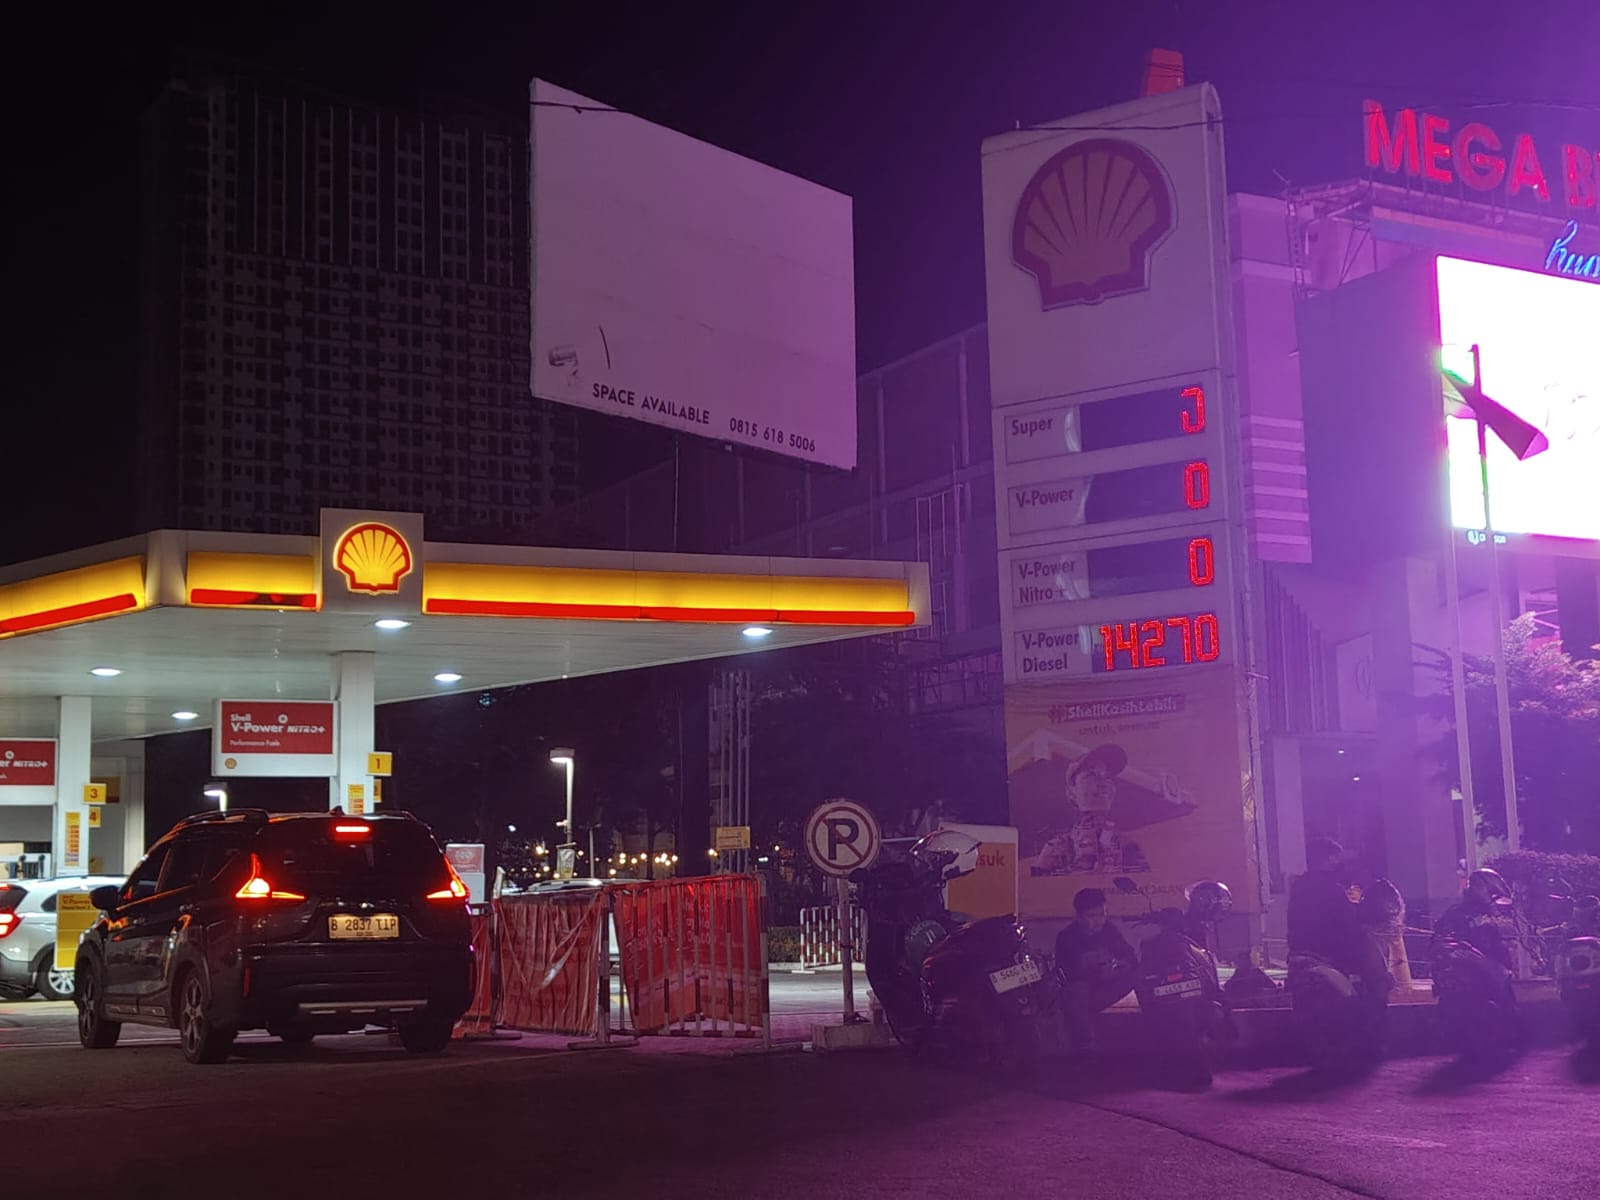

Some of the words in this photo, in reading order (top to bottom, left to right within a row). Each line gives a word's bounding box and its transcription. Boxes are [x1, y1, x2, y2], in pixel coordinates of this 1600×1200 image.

[1364, 99, 1551, 201] MEGA
[1562, 143, 1600, 209] B
[592, 382, 635, 406] SPACE
[641, 396, 710, 425] AVAILABLE
[729, 417, 758, 438] 0815
[763, 427, 784, 444] 618
[789, 433, 816, 453] 5006
[1011, 417, 1053, 437] Super
[1015, 489, 1074, 508] V-Power
[1184, 461, 1210, 511] 0
[1019, 559, 1075, 580] V-Power
[1189, 537, 1215, 587] 0
[1022, 632, 1080, 650] V-Power
[1100, 613, 1220, 672] 14270
[1023, 653, 1068, 673] Diesel
[231, 713, 251, 721] Shell
[231, 723, 284, 732] V-Power
[375, 757, 381, 769] 1
[90, 788, 98, 798] 3
[977, 848, 1005, 867] suk
[331, 919, 338, 931] B
[345, 919, 372, 931] 2837
[376, 918, 397, 931] TIP
